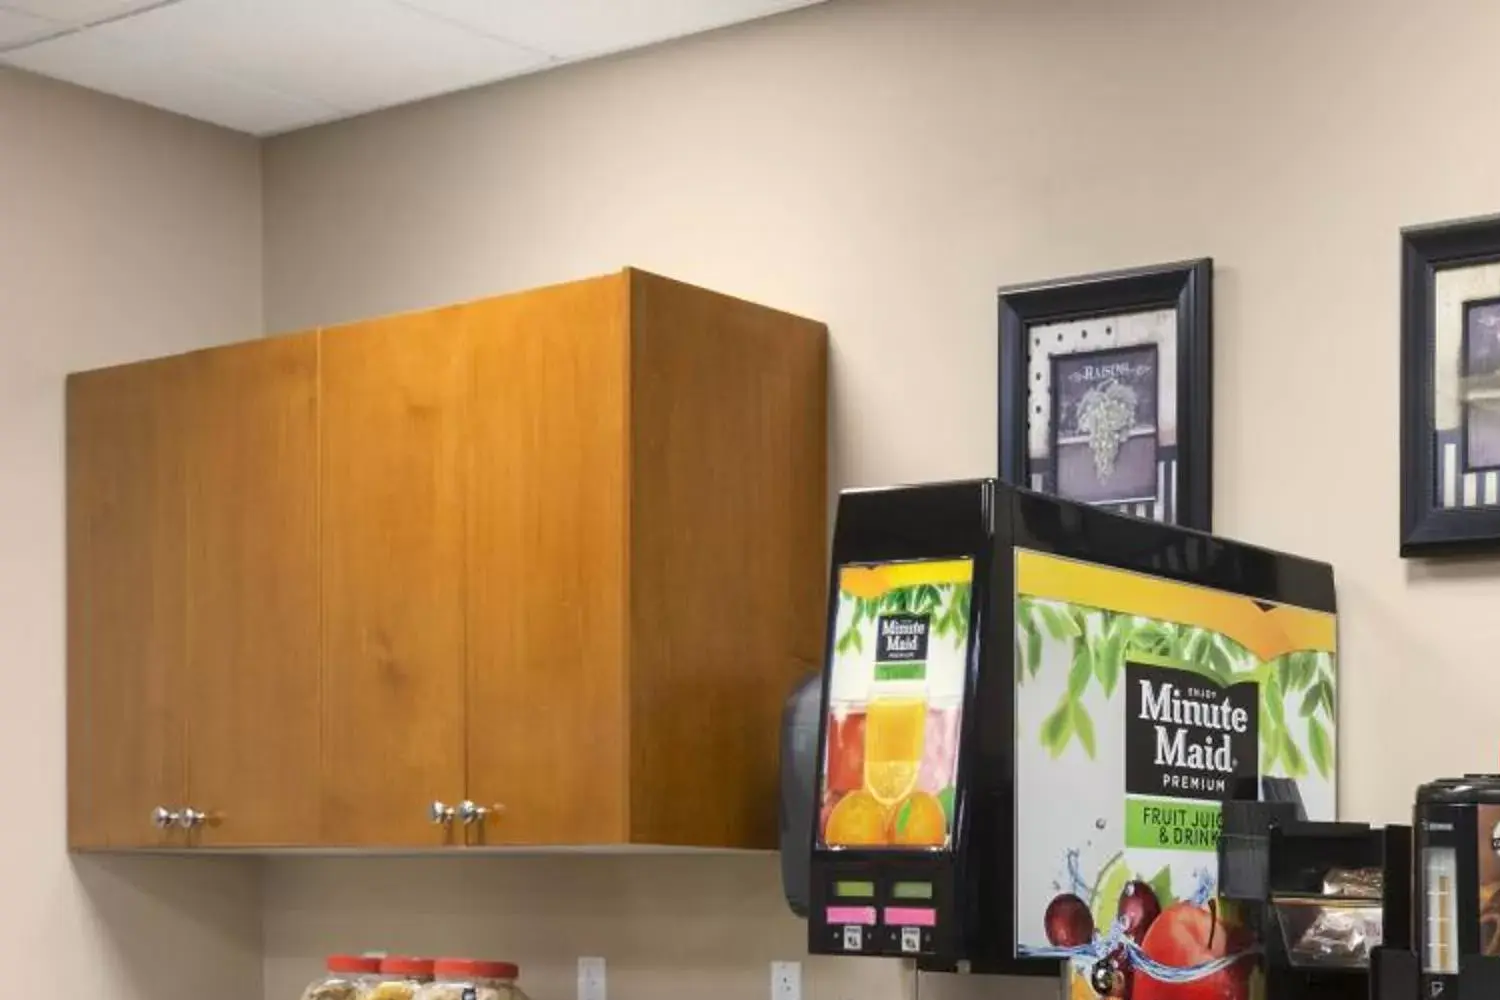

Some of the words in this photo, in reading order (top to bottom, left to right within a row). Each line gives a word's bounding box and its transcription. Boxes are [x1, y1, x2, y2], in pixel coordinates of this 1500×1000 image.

[881, 619, 926, 636] Minute
[886, 635, 919, 651] Maid
[1138, 678, 1249, 733] Minute
[1153, 725, 1233, 773] Maid
[1162, 773, 1226, 792] PREMIUM
[1142, 806, 1188, 826] FRUIT
[1159, 827, 1170, 844] &
